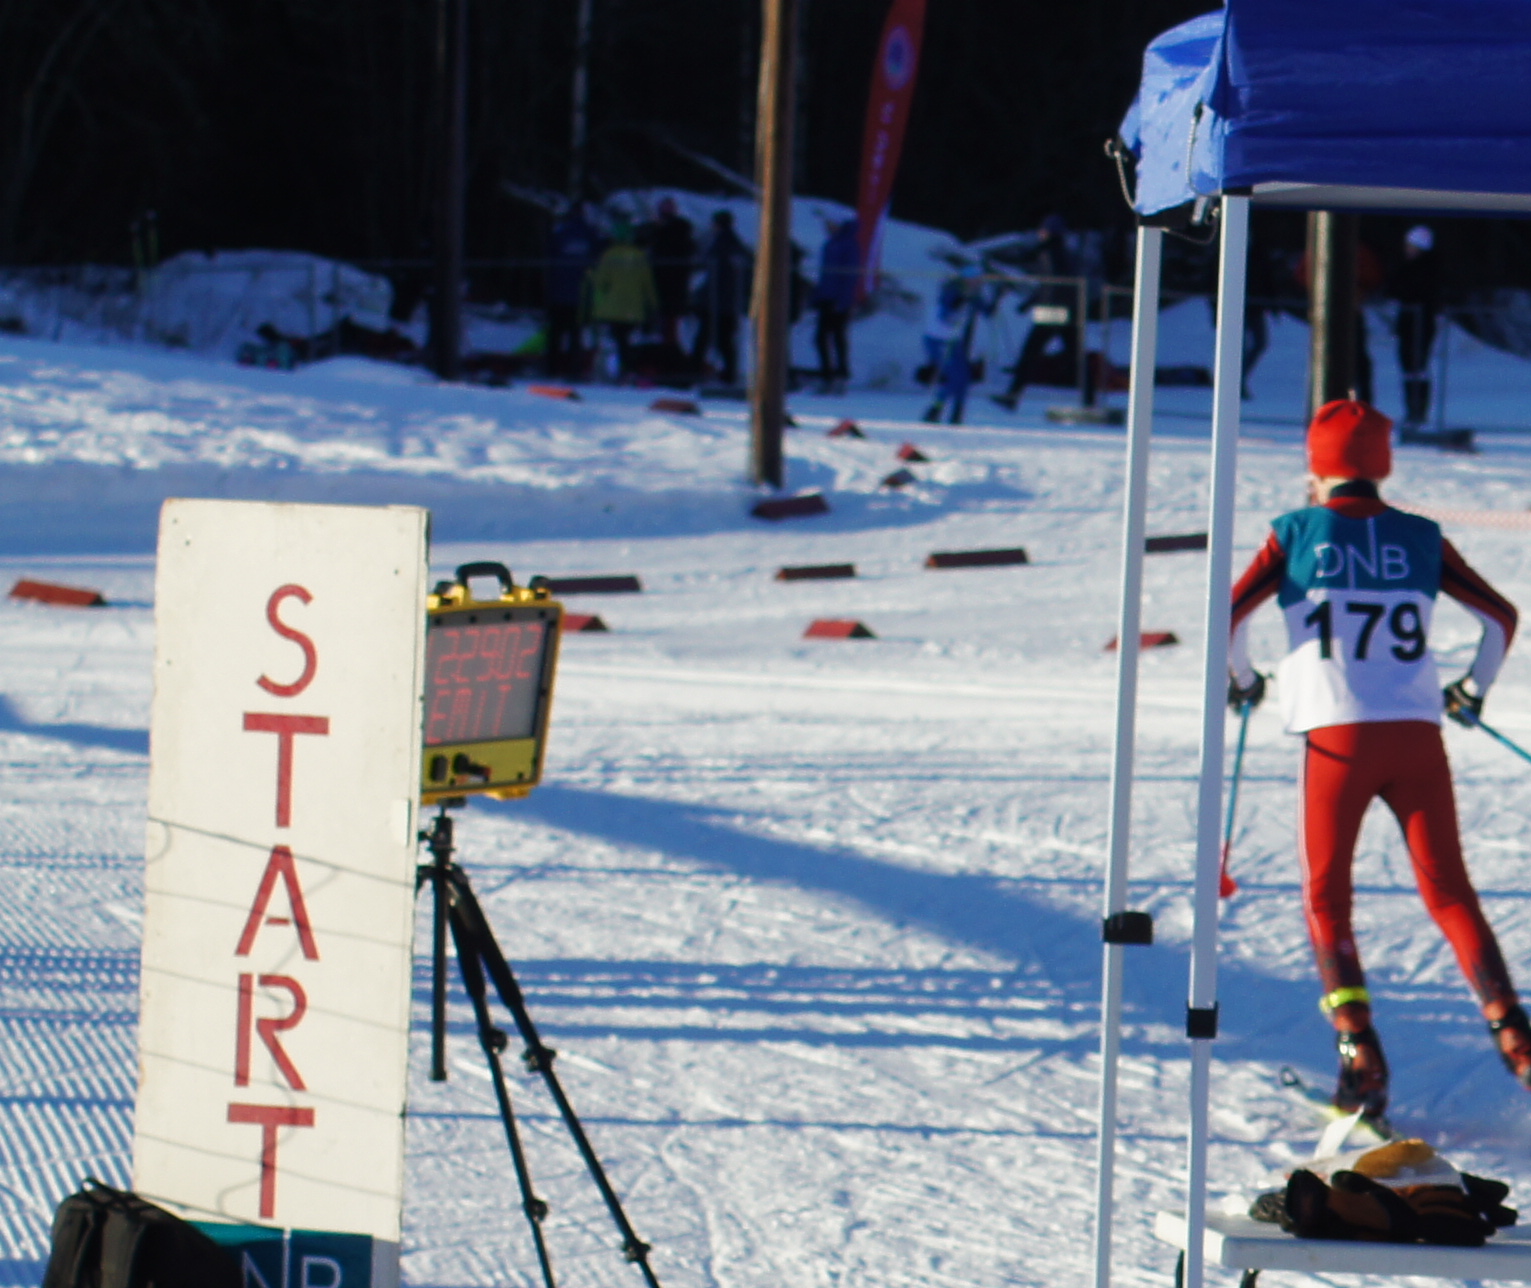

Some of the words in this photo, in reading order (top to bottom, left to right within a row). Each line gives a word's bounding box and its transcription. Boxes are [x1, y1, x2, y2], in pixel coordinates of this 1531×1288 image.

[1315, 517, 1411, 590] DNB
[1305, 602, 1426, 662] 179
[227, 583, 330, 1219] START
